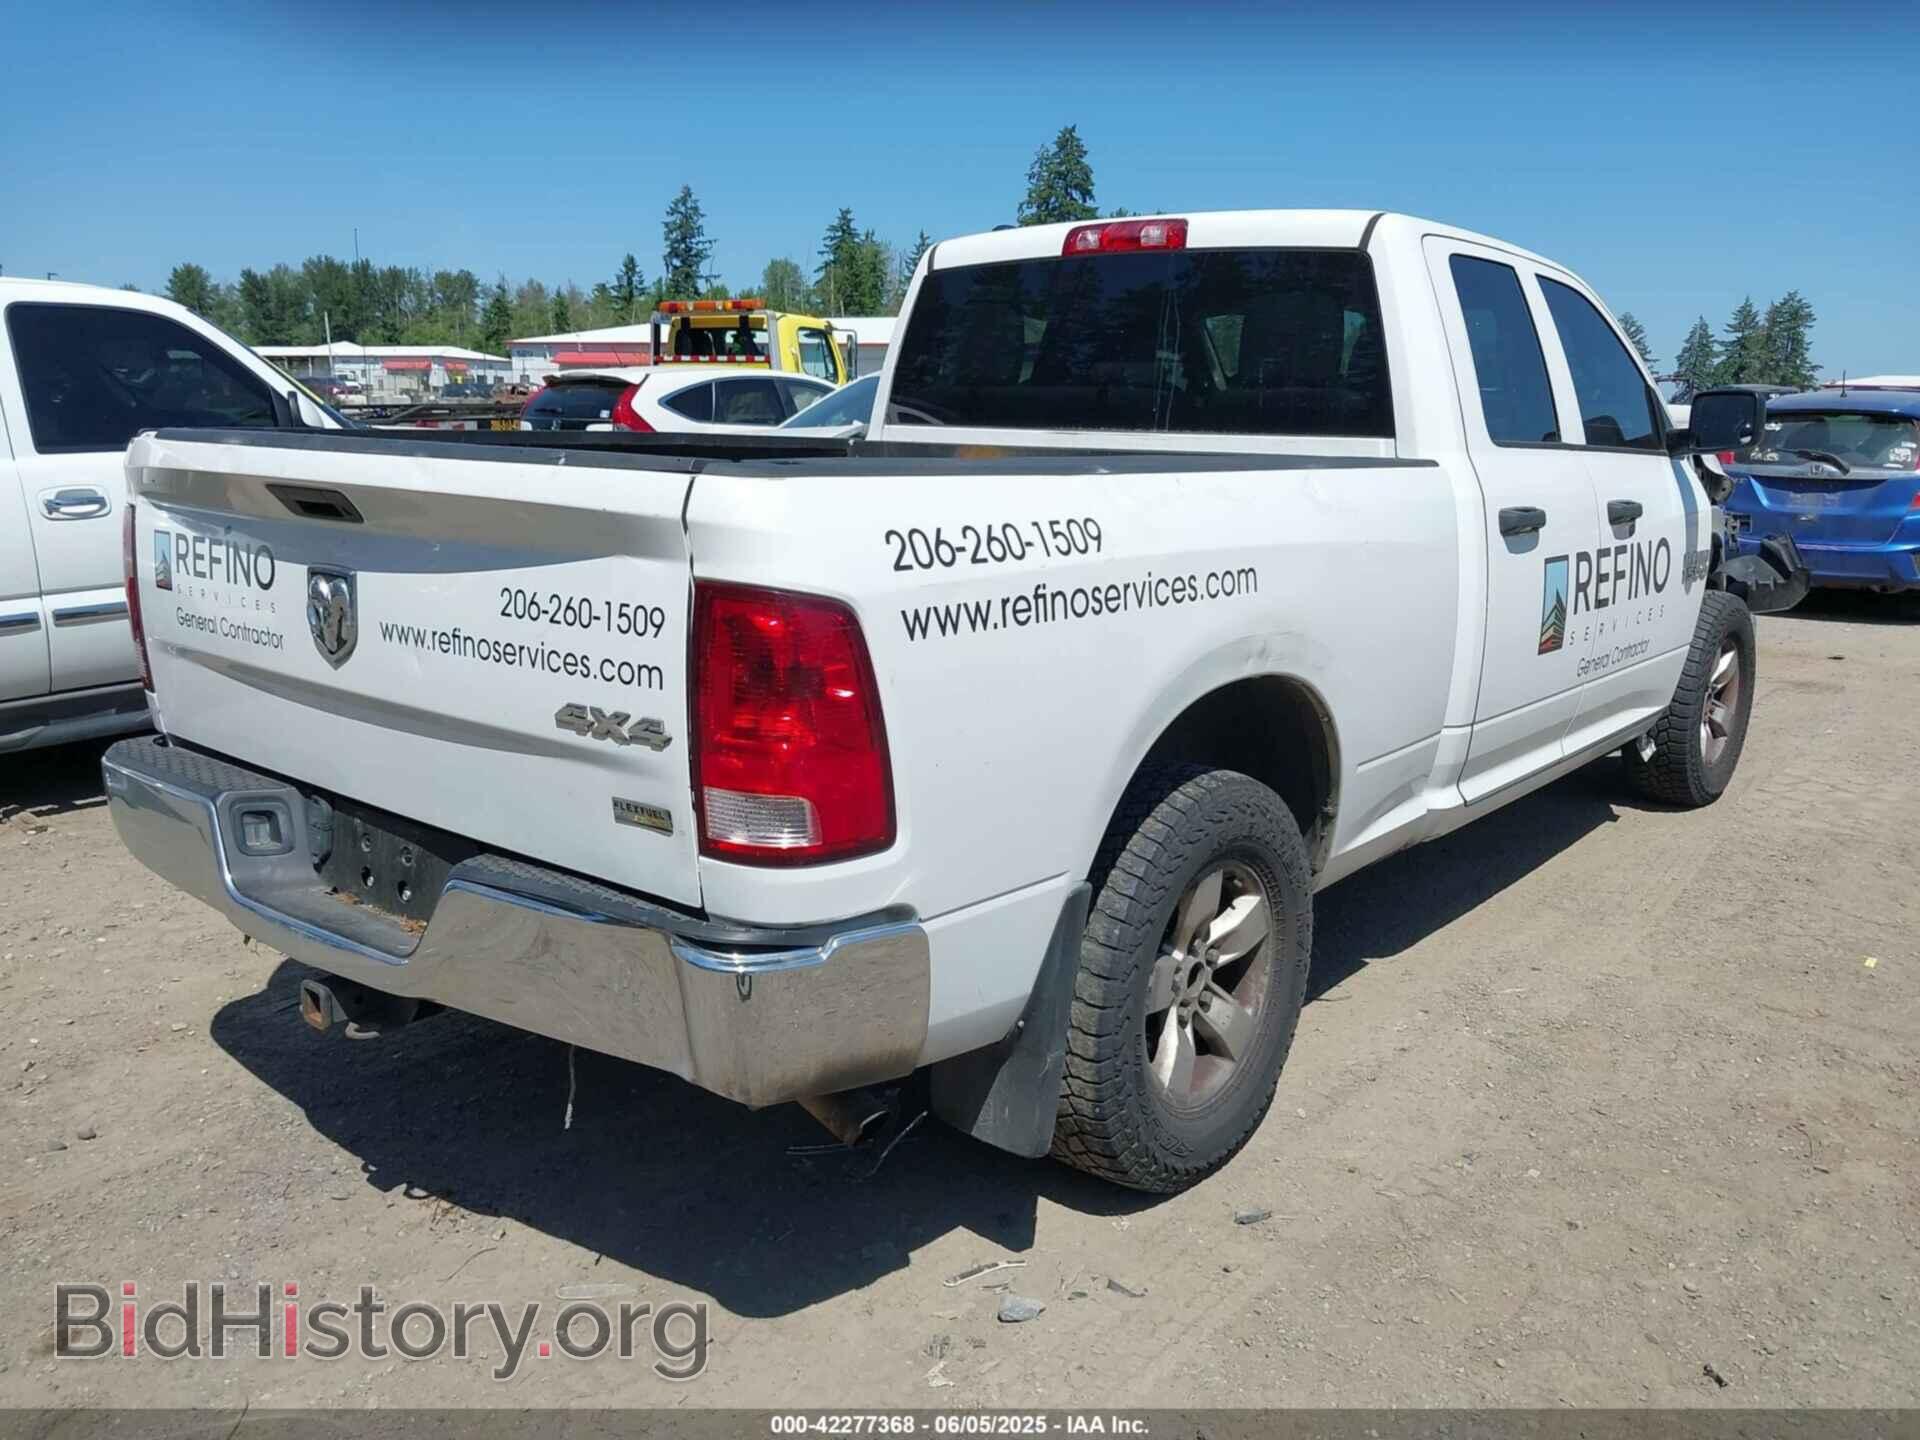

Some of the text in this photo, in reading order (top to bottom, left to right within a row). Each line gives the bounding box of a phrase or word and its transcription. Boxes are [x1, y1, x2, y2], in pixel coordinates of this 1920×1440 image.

[175, 532, 276, 591] REFINO
[885, 517, 1103, 571] 206-260-1509
[177, 583, 276, 614] SERVICES
[1573, 537, 1671, 615] REFINO
[176, 606, 284, 650] General Contractor
[499, 587, 665, 639] 206-260-1509
[901, 566, 1258, 642] www.refinoservices.com
[1569, 604, 1665, 646] SERVICES
[380, 622, 664, 690] www.refinoservices.com
